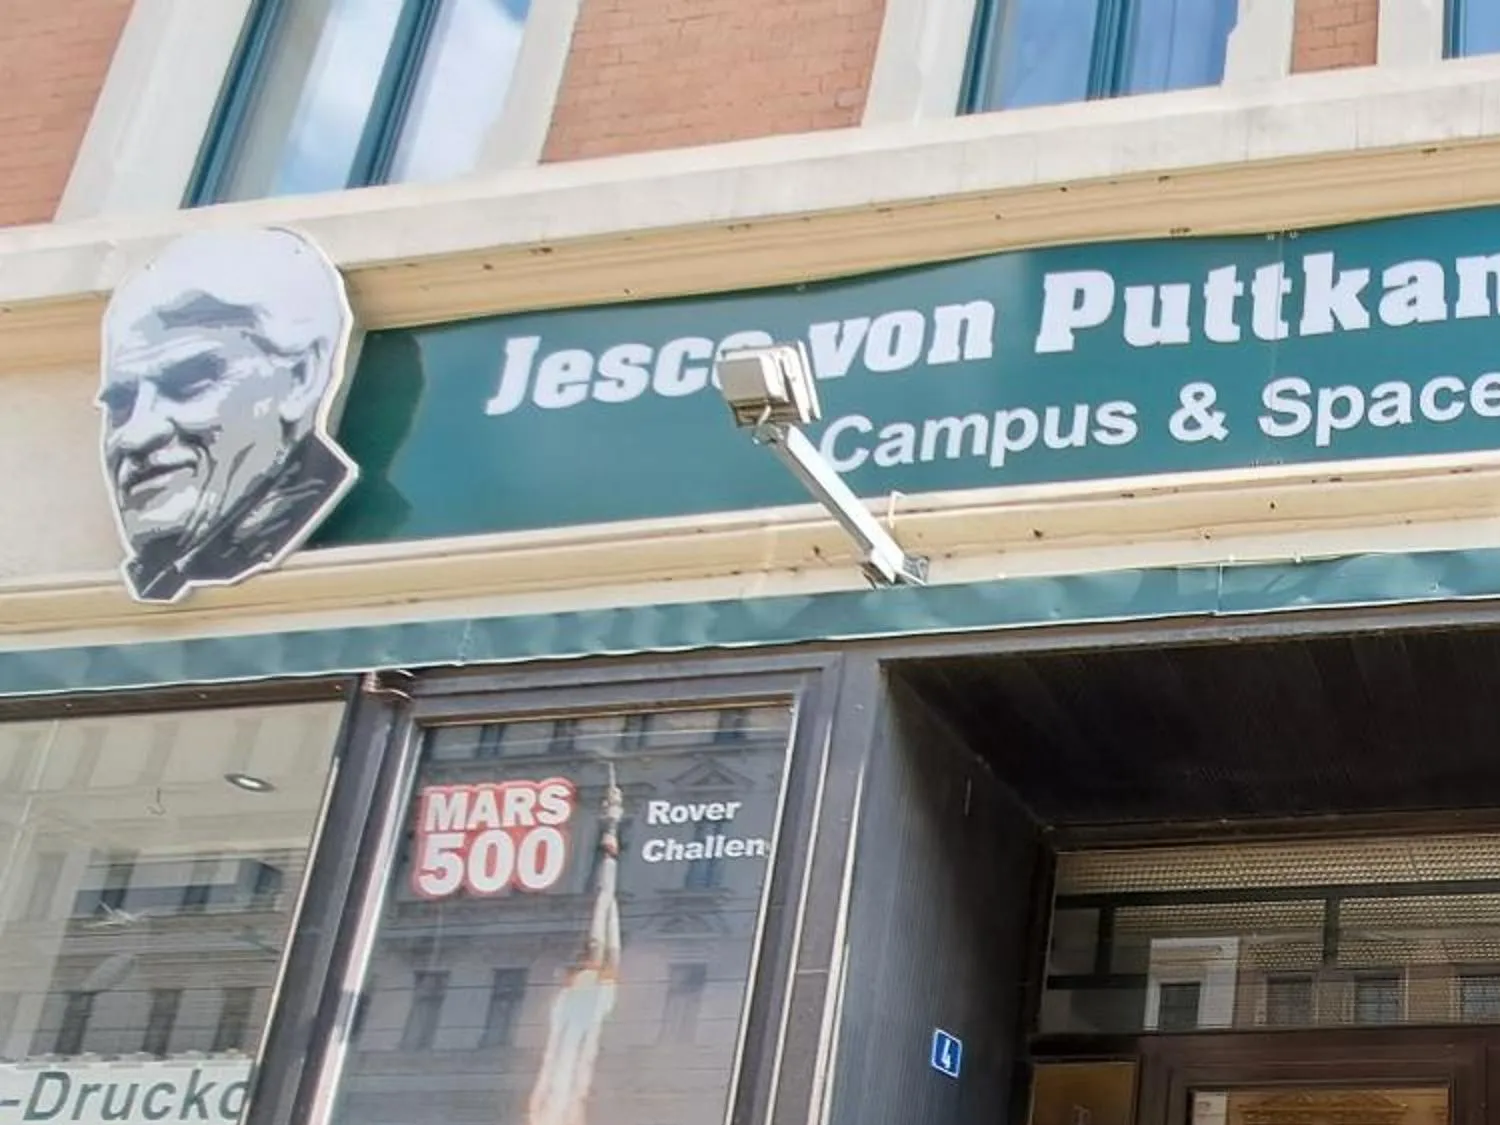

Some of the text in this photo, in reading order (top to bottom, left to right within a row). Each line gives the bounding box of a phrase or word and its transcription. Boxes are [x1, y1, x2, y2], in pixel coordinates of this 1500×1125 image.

[484, 330, 774, 416] Jesc
[808, 298, 996, 380] von
[820, 397, 1138, 473] Campus
[1168, 382, 1227, 443] &
[424, 785, 573, 832] MARS
[647, 800, 742, 825] Rover
[418, 826, 566, 897] 500
[641, 835, 769, 862] Challen
